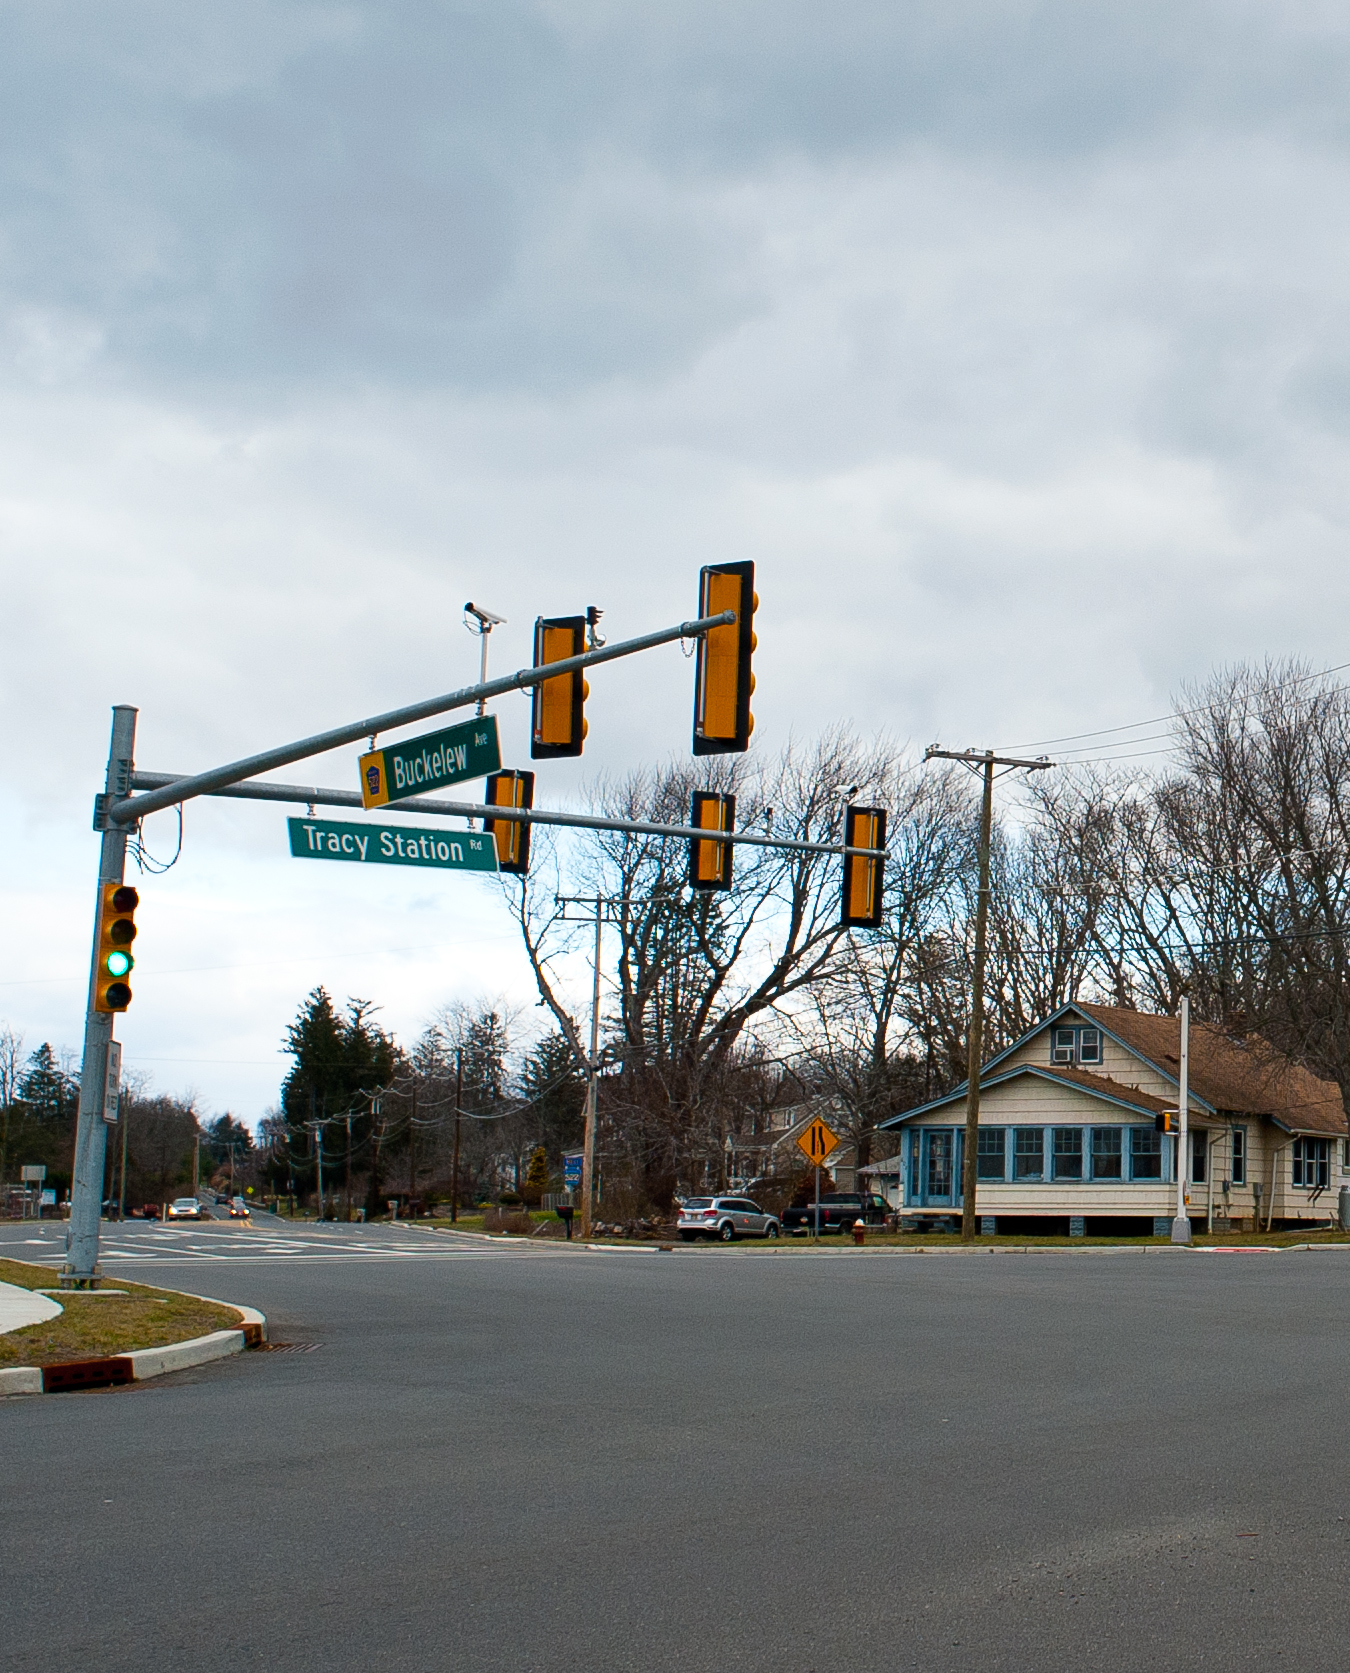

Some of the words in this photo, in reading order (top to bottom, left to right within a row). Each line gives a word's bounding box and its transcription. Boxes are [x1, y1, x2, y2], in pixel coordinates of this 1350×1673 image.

[393, 743, 467, 789] Buckelew
[303, 825, 369, 861] Tracy
[380, 831, 464, 862] Station
[469, 839, 483, 851] Rd
